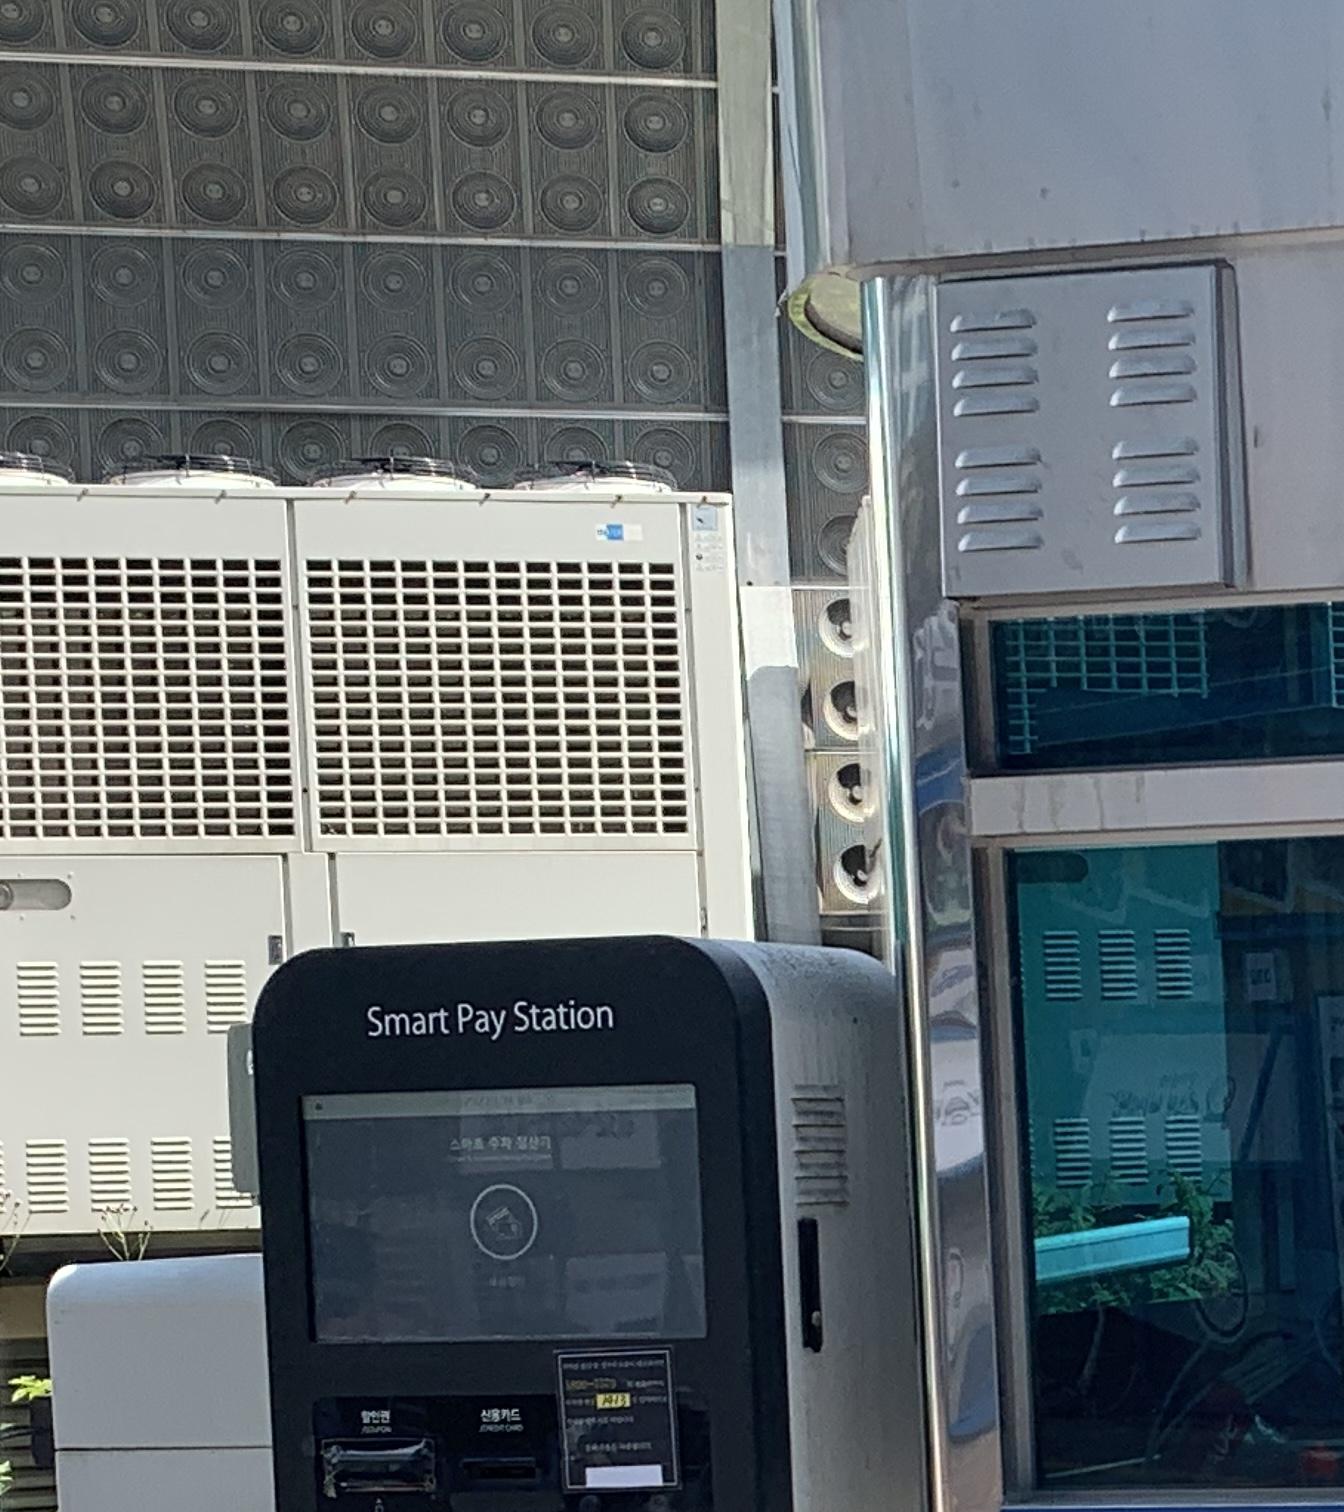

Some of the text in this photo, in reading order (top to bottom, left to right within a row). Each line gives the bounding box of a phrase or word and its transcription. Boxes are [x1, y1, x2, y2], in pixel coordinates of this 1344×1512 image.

[368, 1000, 613, 1040] Smart Pay Station
[361, 1410, 390, 1424] 할인권
[480, 1408, 521, 1422] 신용카드
